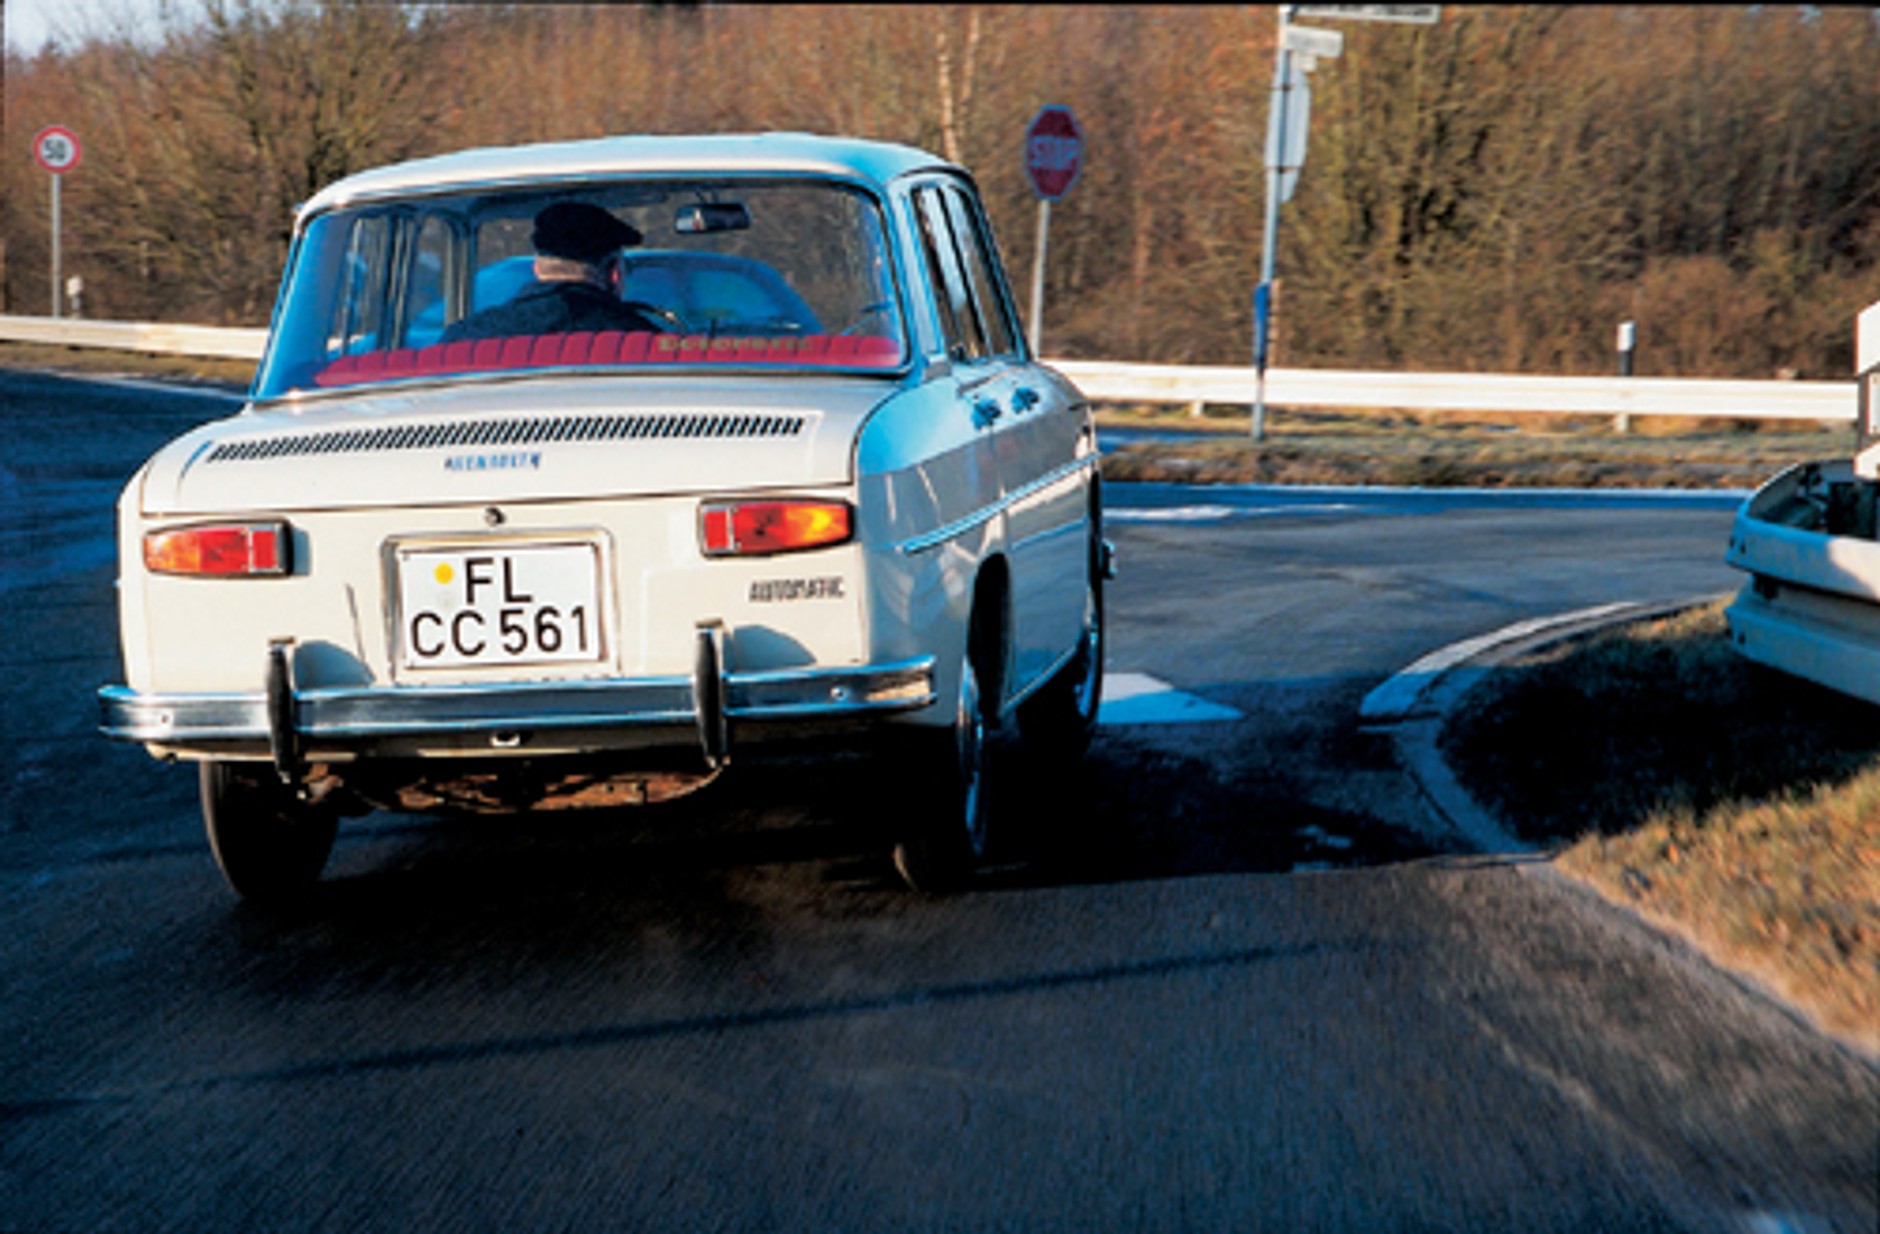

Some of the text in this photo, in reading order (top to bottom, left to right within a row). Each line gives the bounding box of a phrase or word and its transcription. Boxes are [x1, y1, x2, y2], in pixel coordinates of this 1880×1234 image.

[465, 557, 532, 604] FL
[748, 577, 845, 602] AUTOMATIC
[411, 605, 587, 657] CC 561
